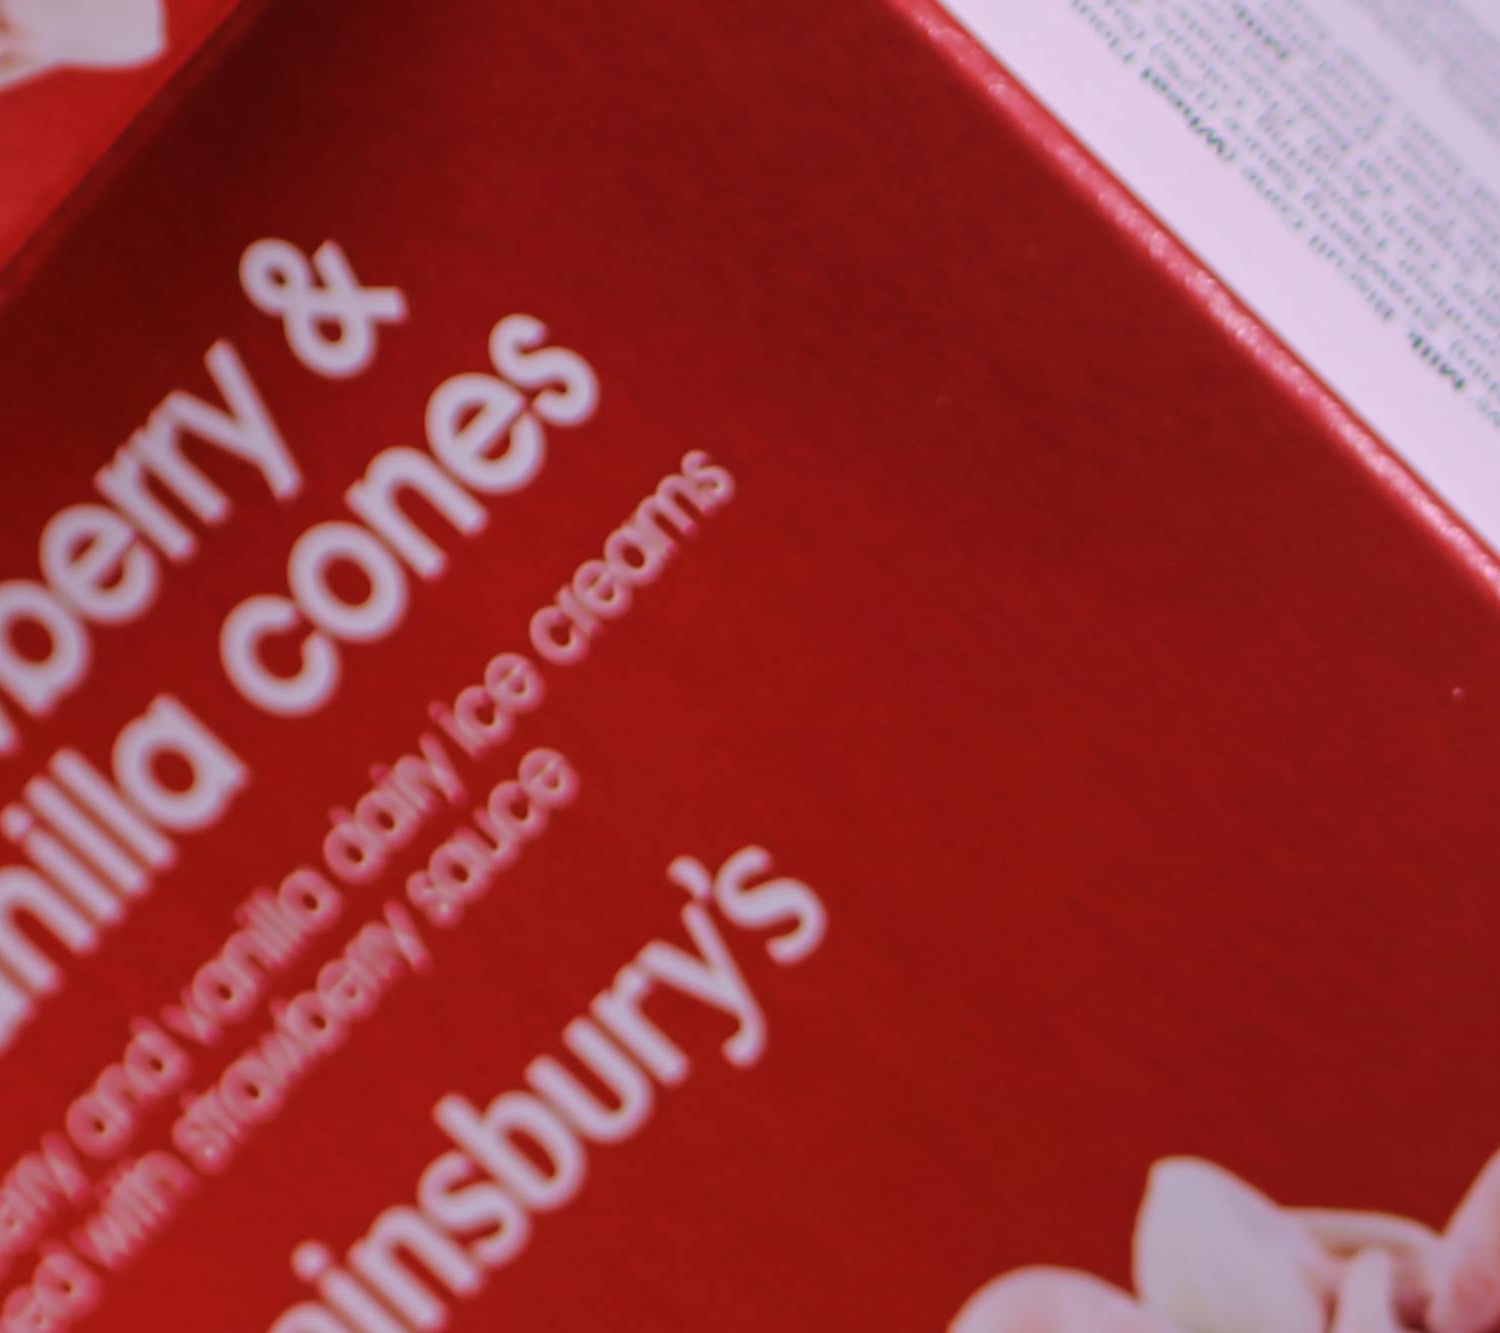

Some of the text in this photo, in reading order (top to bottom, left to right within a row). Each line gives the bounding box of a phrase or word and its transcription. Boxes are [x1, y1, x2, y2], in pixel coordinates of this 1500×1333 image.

[218, 314, 602, 717] cones
[238, 238, 408, 378] &
[66, 1015, 190, 1152] and
[167, 868, 340, 1047] vanilla
[320, 732, 463, 886] dairy
[434, 652, 543, 762] ice
[531, 449, 738, 666] creams
[78, 1150, 200, 1271] with
[172, 900, 433, 1177] strawberry
[404, 746, 582, 925] sauce
